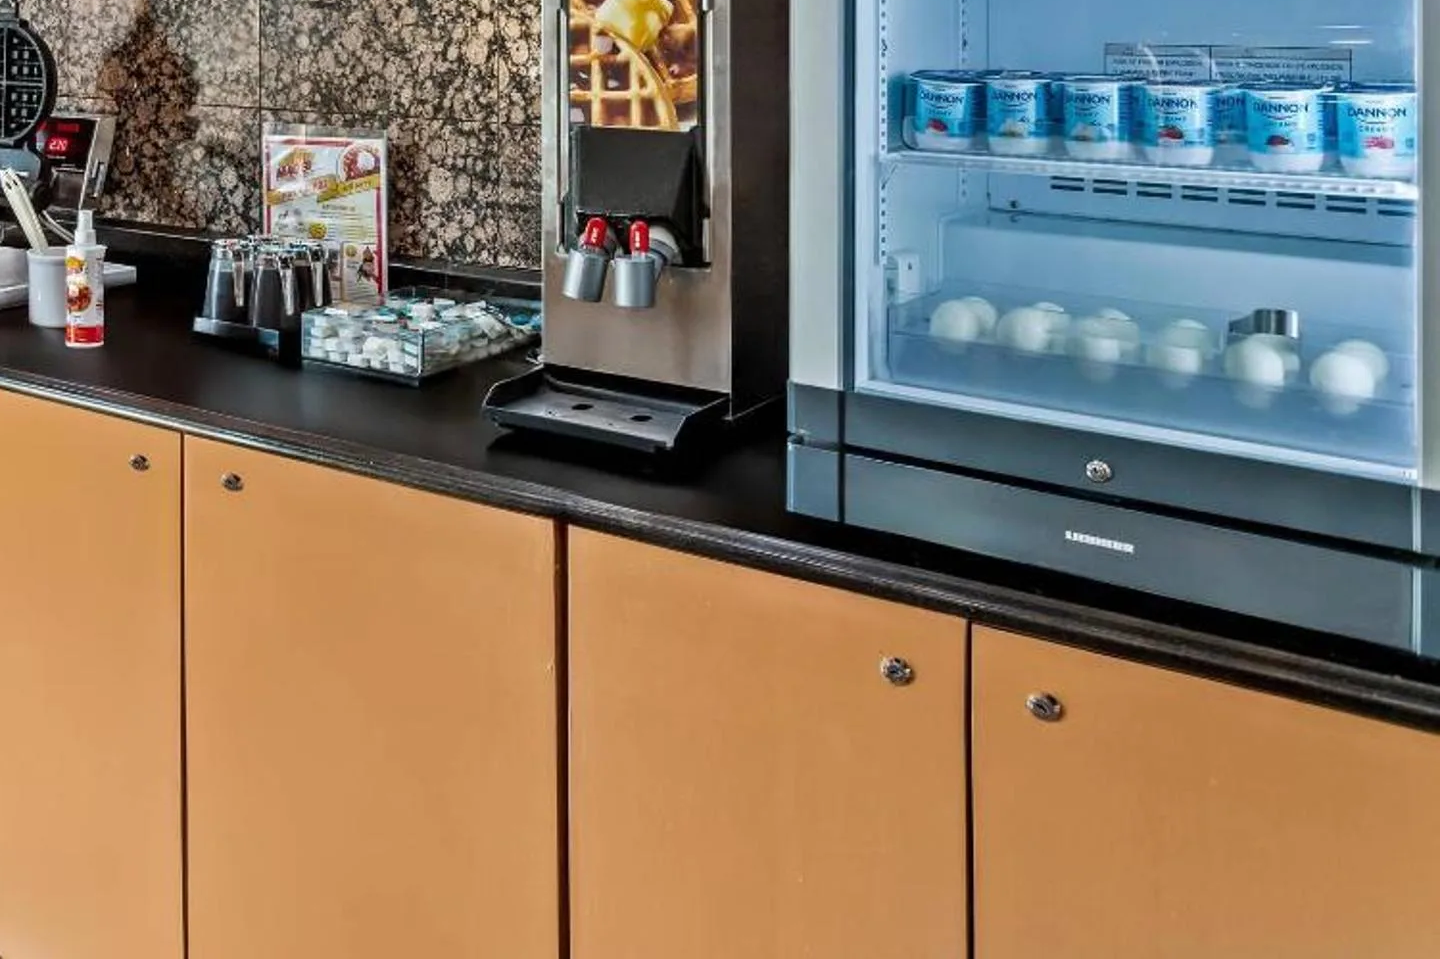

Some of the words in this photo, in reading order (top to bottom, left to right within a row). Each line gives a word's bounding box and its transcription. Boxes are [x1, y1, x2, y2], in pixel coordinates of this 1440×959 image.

[1148, 96, 1198, 109] DANNON
[1253, 102, 1308, 115] DANNON
[1347, 107, 1407, 119] DANNON
